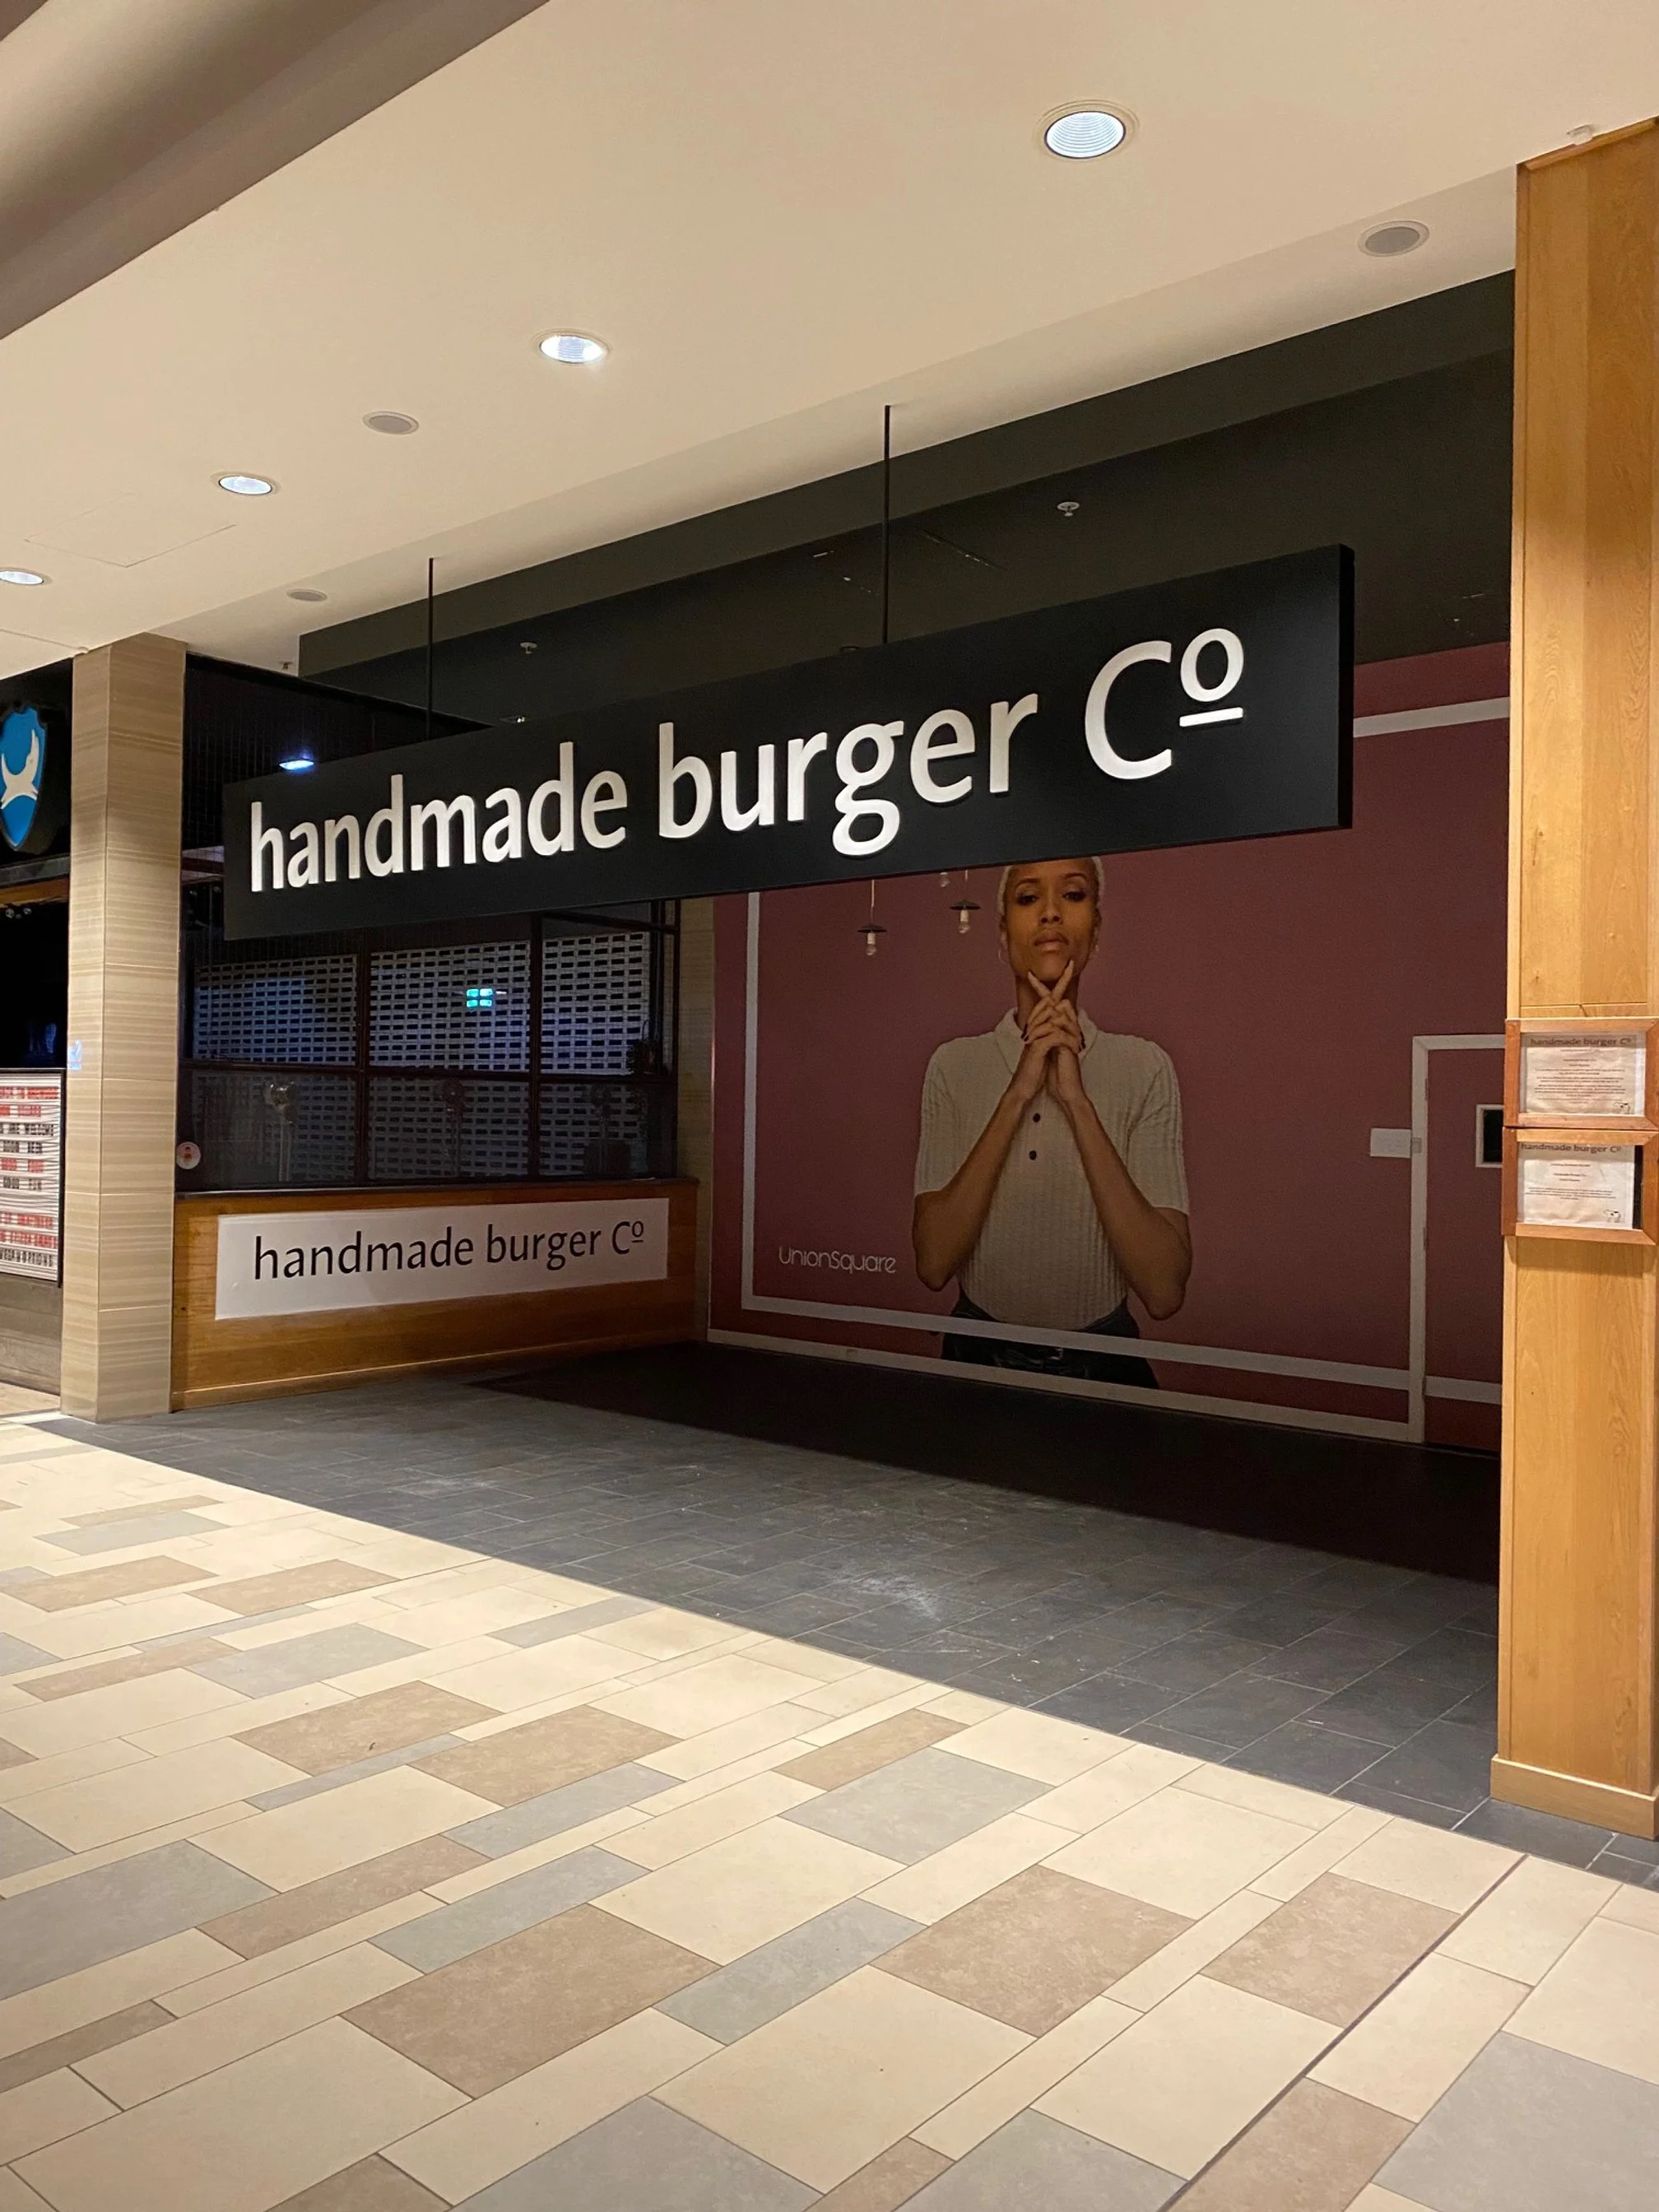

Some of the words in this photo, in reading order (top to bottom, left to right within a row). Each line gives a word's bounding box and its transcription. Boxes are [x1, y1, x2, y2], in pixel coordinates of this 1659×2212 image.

[250, 741, 628, 892] handmade
[658, 694, 1039, 856] burger
[1530, 1037, 1580, 1046] handmade
[1582, 1038, 1618, 1047] burger
[1520, 1143, 1572, 1152] handmade
[1573, 1144, 1608, 1154] burger
[253, 1225, 475, 1280] handmade
[486, 1223, 602, 1271] burger
